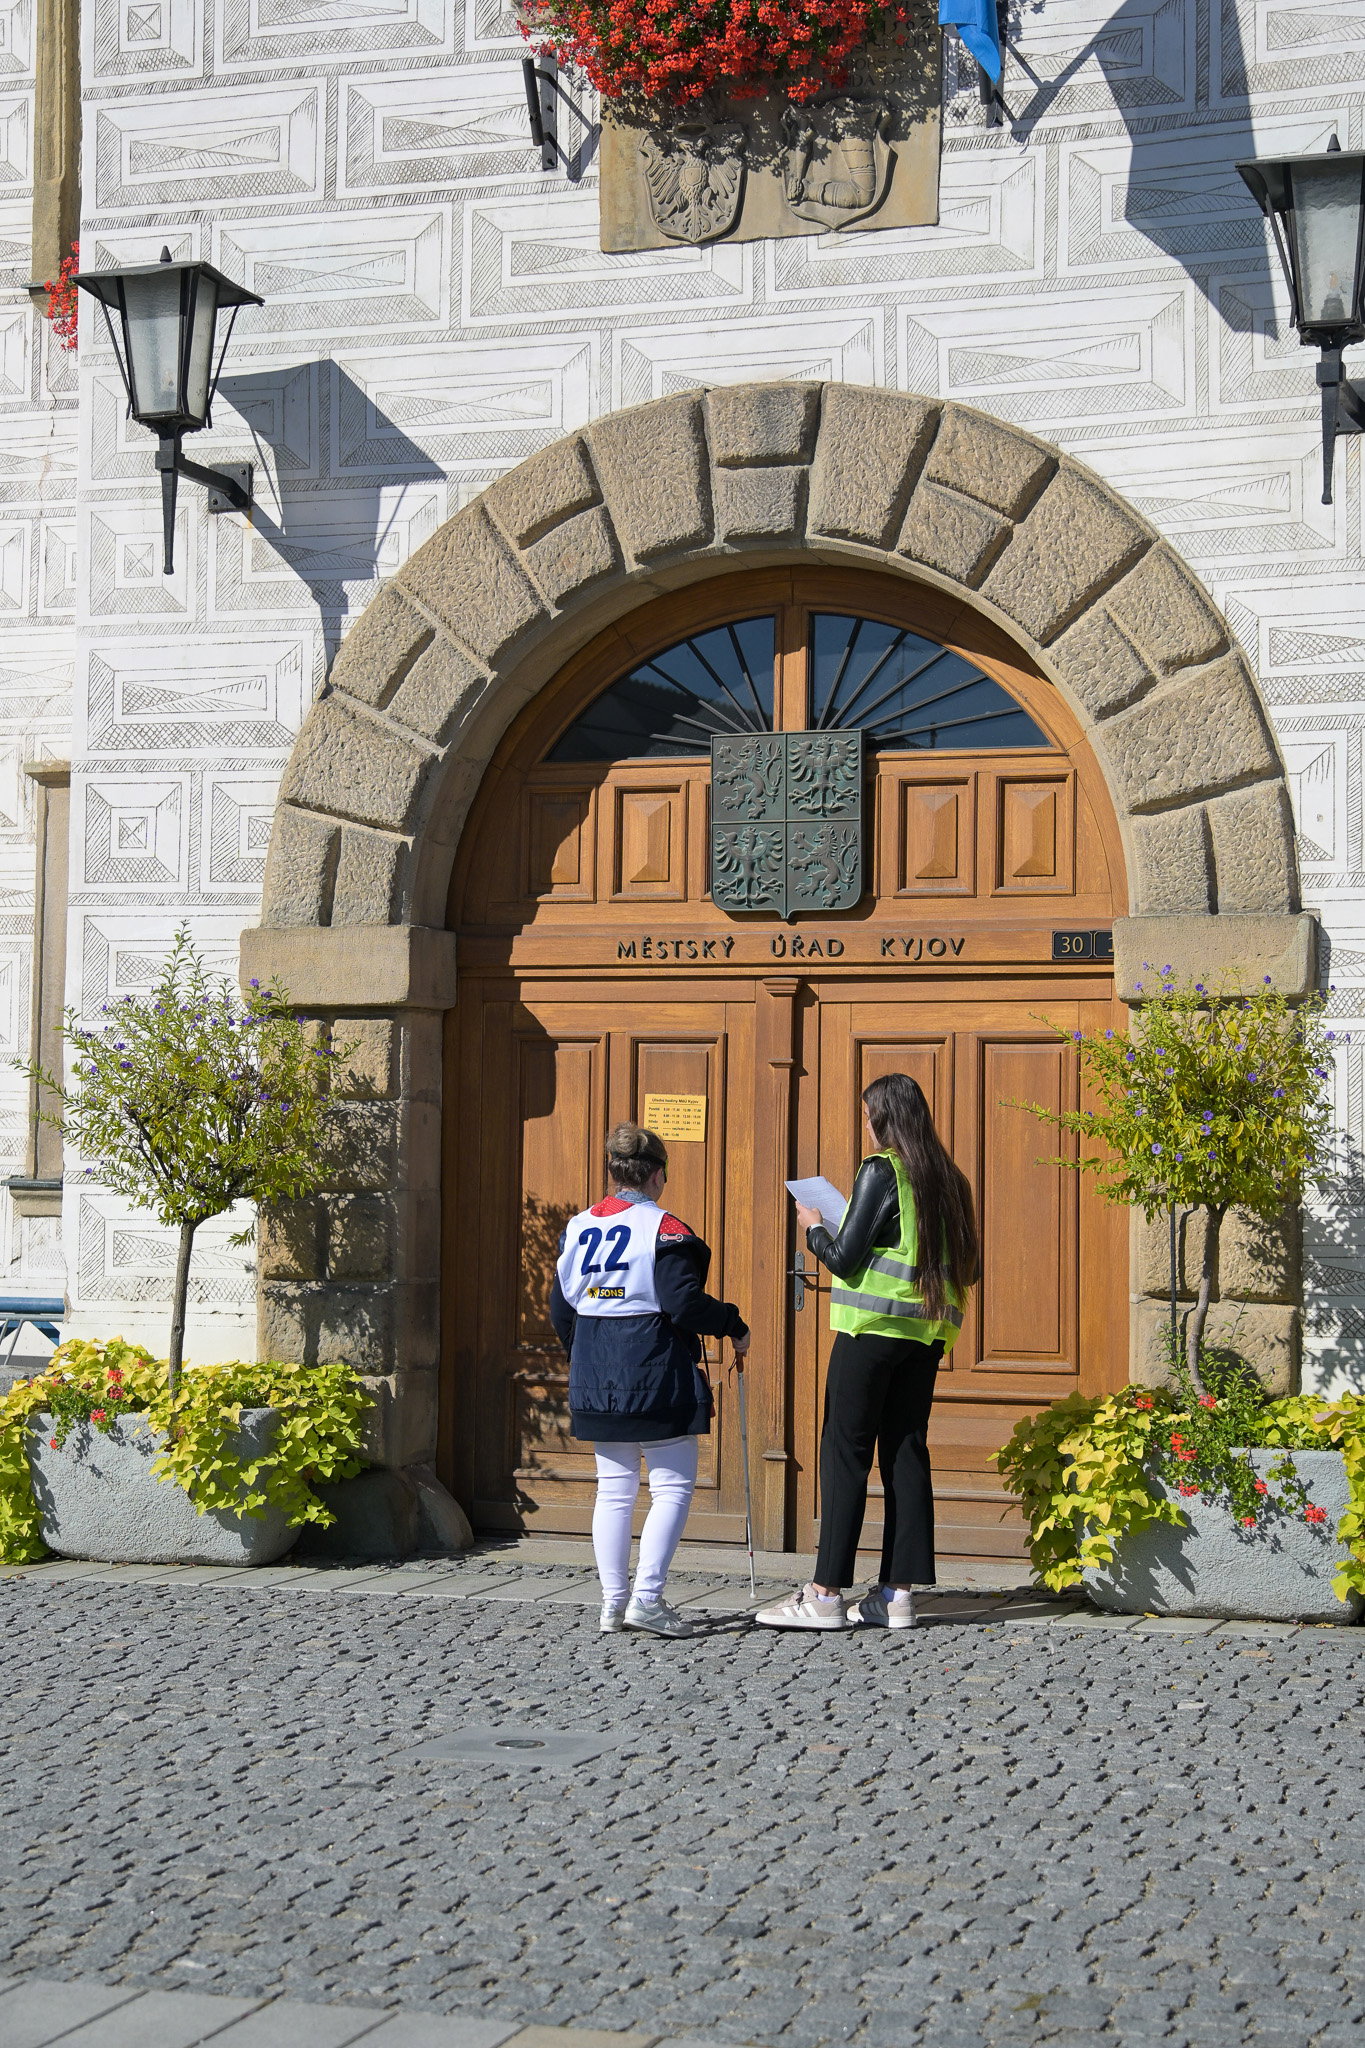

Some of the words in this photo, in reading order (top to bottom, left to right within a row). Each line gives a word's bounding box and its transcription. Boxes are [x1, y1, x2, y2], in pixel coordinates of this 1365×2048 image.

[617, 936, 735, 960] MĚSTSKÝ
[770, 934, 845, 959] ÚŘAD
[880, 937, 966, 961] KYJOV
[1061, 936, 1084, 953] 30
[578, 1224, 632, 1276] 22
[599, 1288, 624, 1297] SONS
